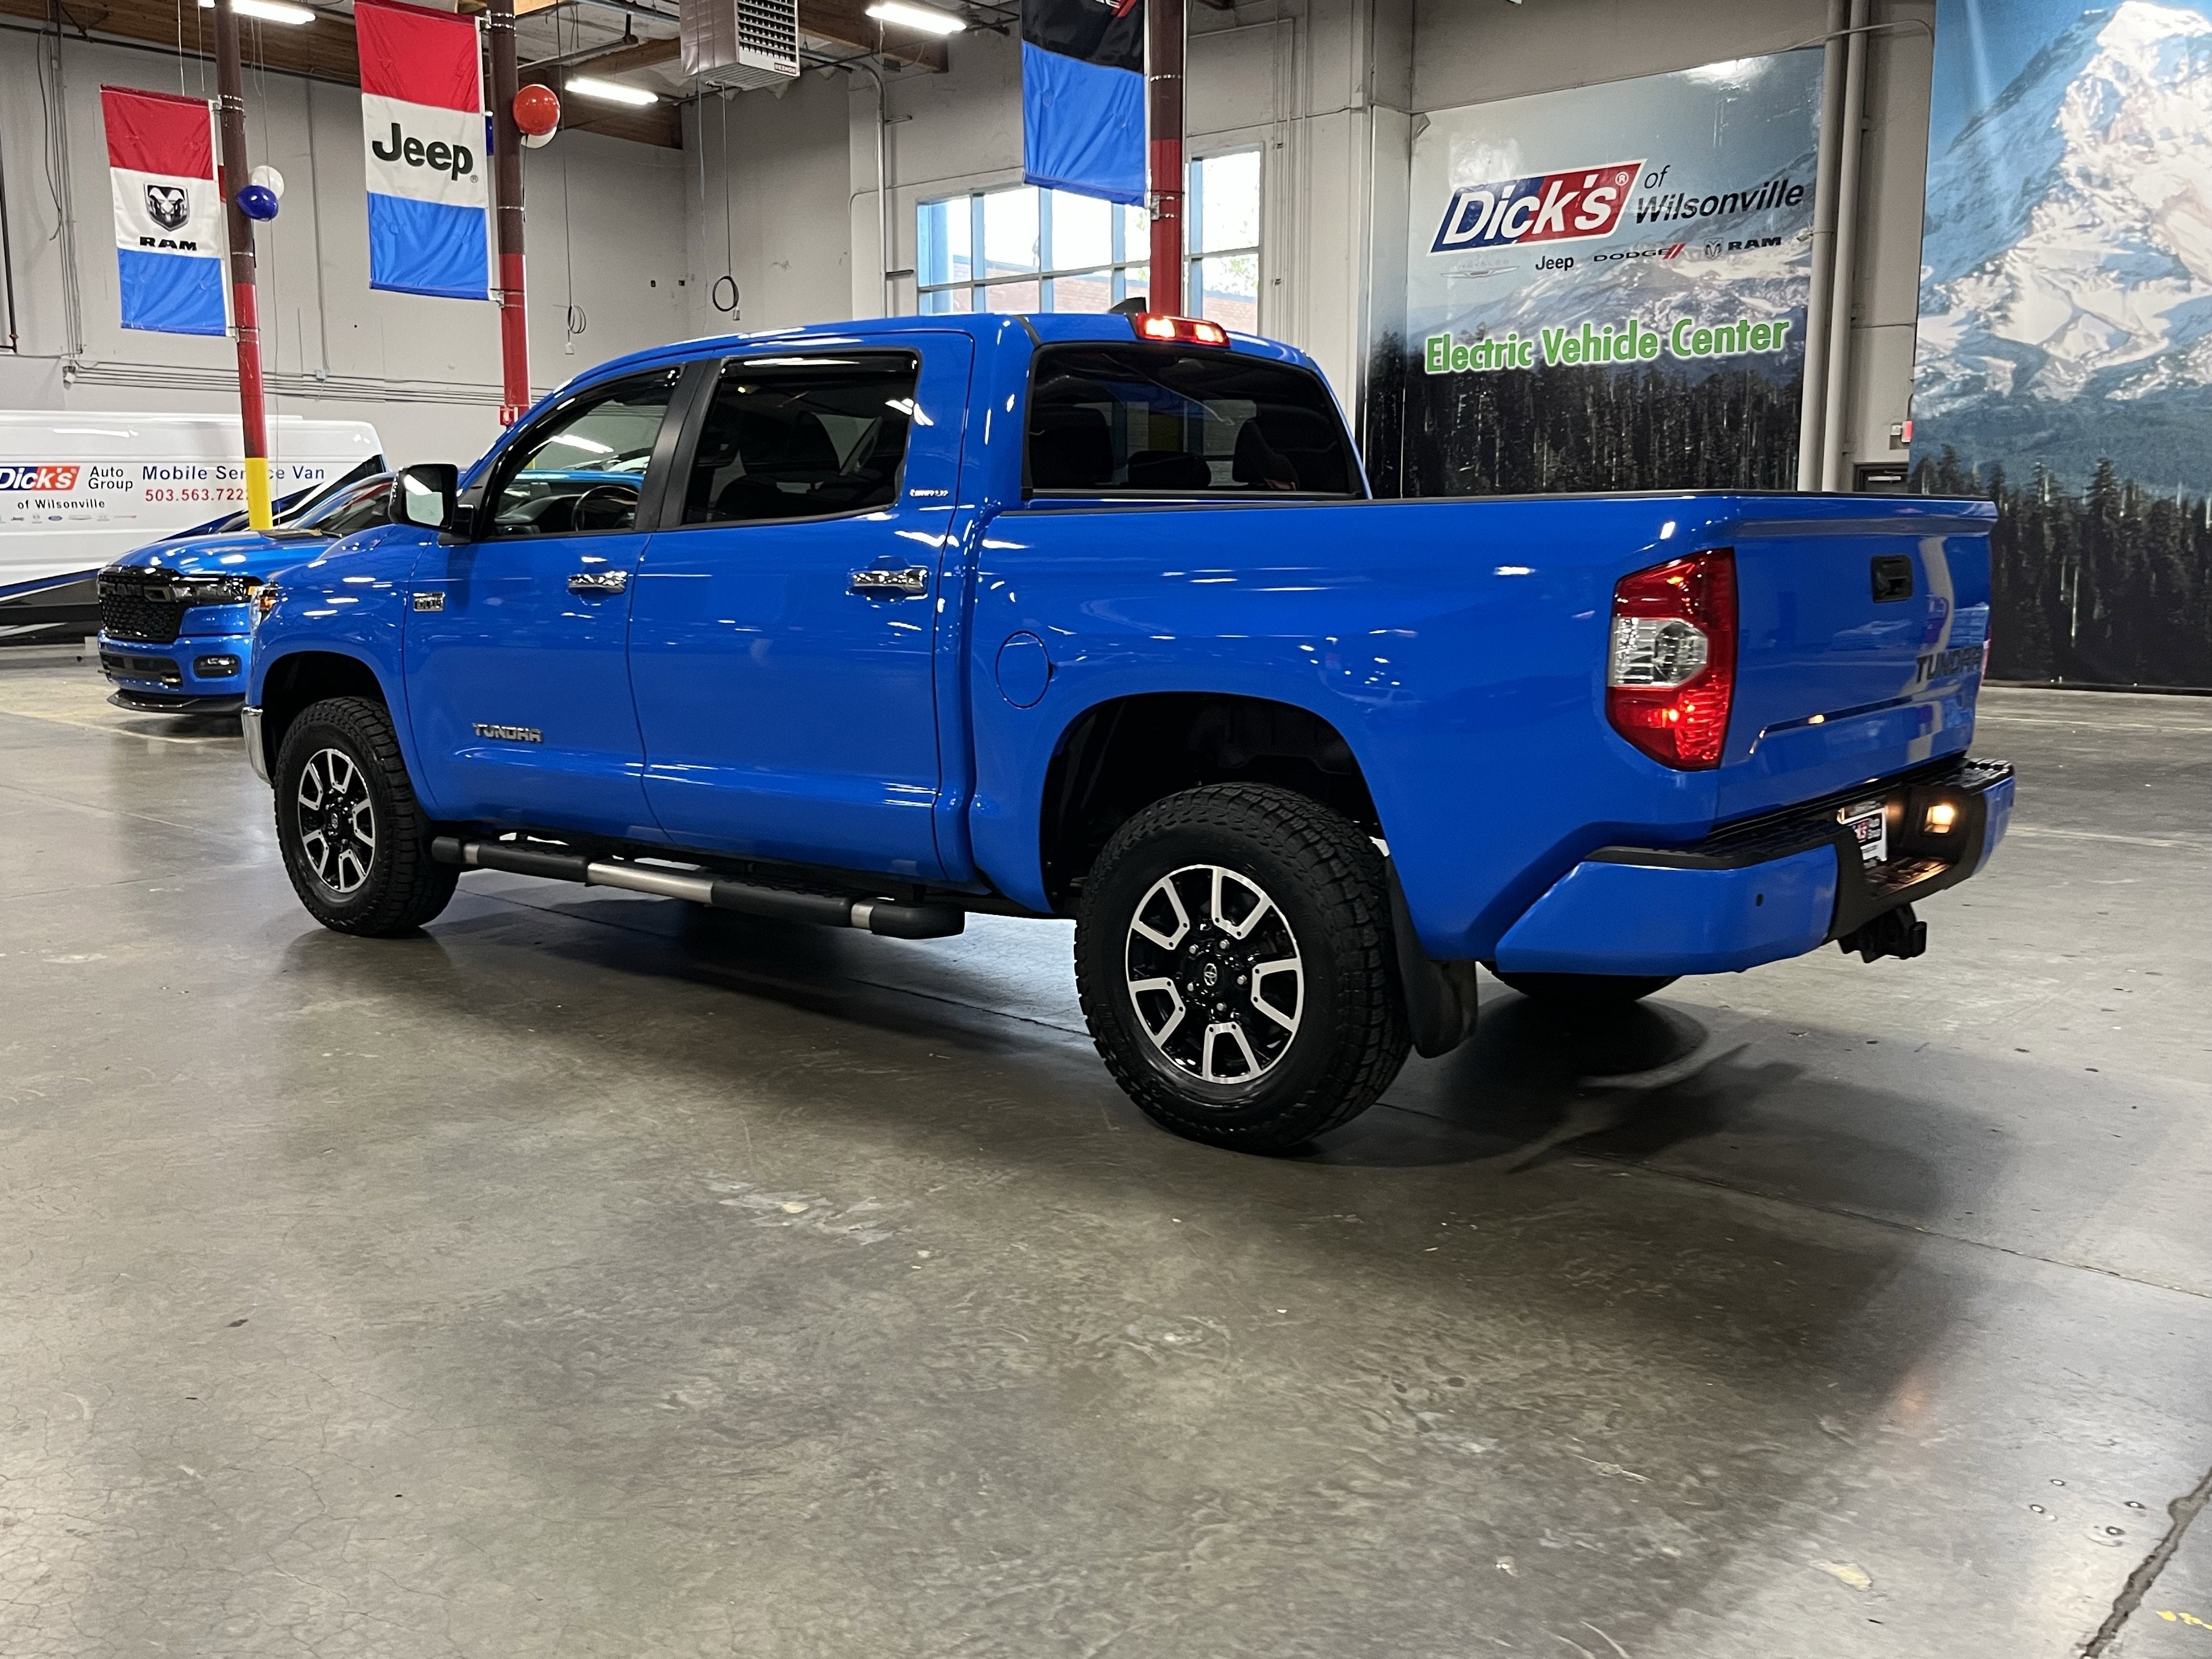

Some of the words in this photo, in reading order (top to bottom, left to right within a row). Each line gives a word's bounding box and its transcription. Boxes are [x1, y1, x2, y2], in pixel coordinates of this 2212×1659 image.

[1644, 165, 1671, 189] of
[1635, 178, 1804, 224] Wilsonville
[139, 236, 197, 251] RAM
[1728, 236, 1782, 251] RAM
[1593, 248, 1671, 262] DODGE
[1535, 255, 1574, 271] Jeep
[1426, 334, 1532, 373] Electric
[1542, 320, 1658, 366] Vehicle
[1672, 319, 1790, 357] Center
[89, 466, 123, 477] Auto
[142, 466, 207, 480] Mobile
[216, 466, 285, 480] Serce
[292, 466, 324, 479] Van
[88, 478, 133, 492] Group
[145, 488, 248, 501] 503.563.722
[18, 500, 29, 509] of
[35, 499, 105, 509] Wilsonville
[472, 723, 542, 742] TUNDRA
